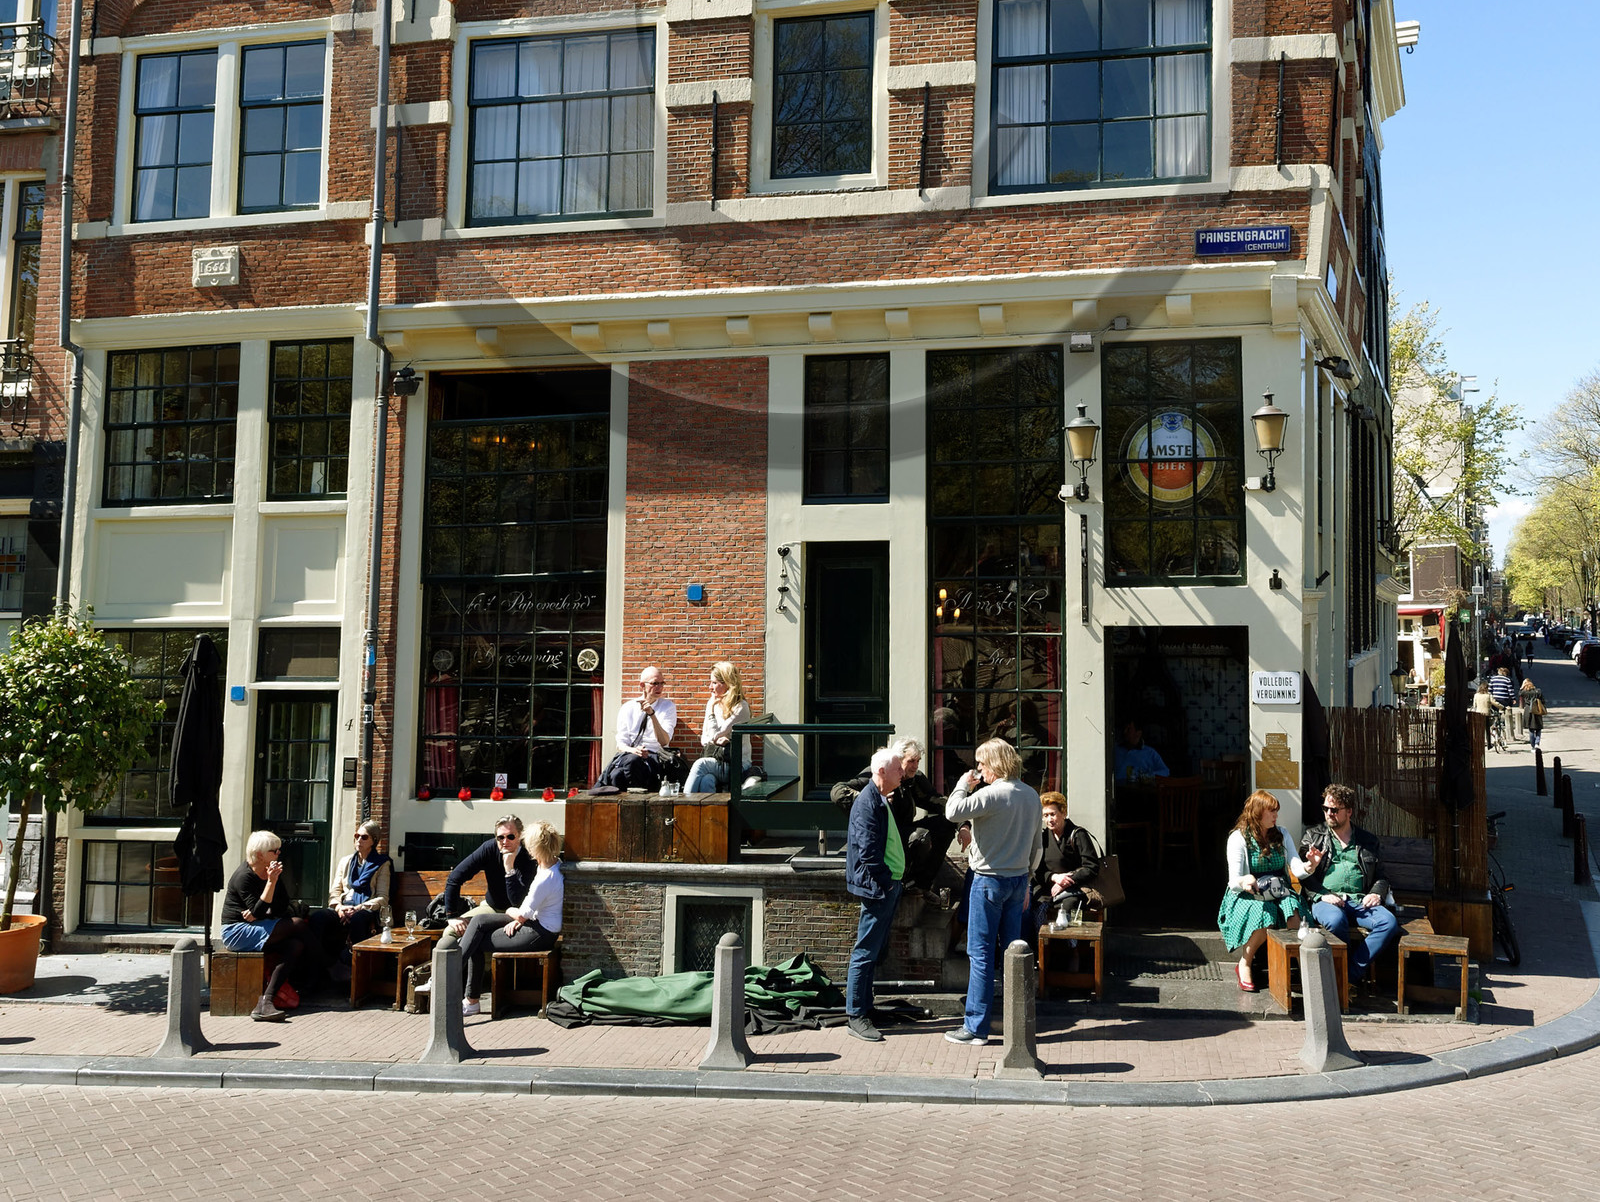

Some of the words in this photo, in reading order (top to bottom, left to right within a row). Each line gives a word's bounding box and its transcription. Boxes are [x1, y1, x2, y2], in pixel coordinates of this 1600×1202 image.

[1199, 229, 1287, 244] PRINSENGRACHT
[1244, 242, 1288, 251] (CENTRUM)
[1156, 462, 1186, 471] BIER
[1080, 670, 1093, 686] 2
[1258, 676, 1293, 687] VOLLEDIGE
[1256, 689, 1297, 700] VERGUNNING
[344, 718, 354, 731] 4
